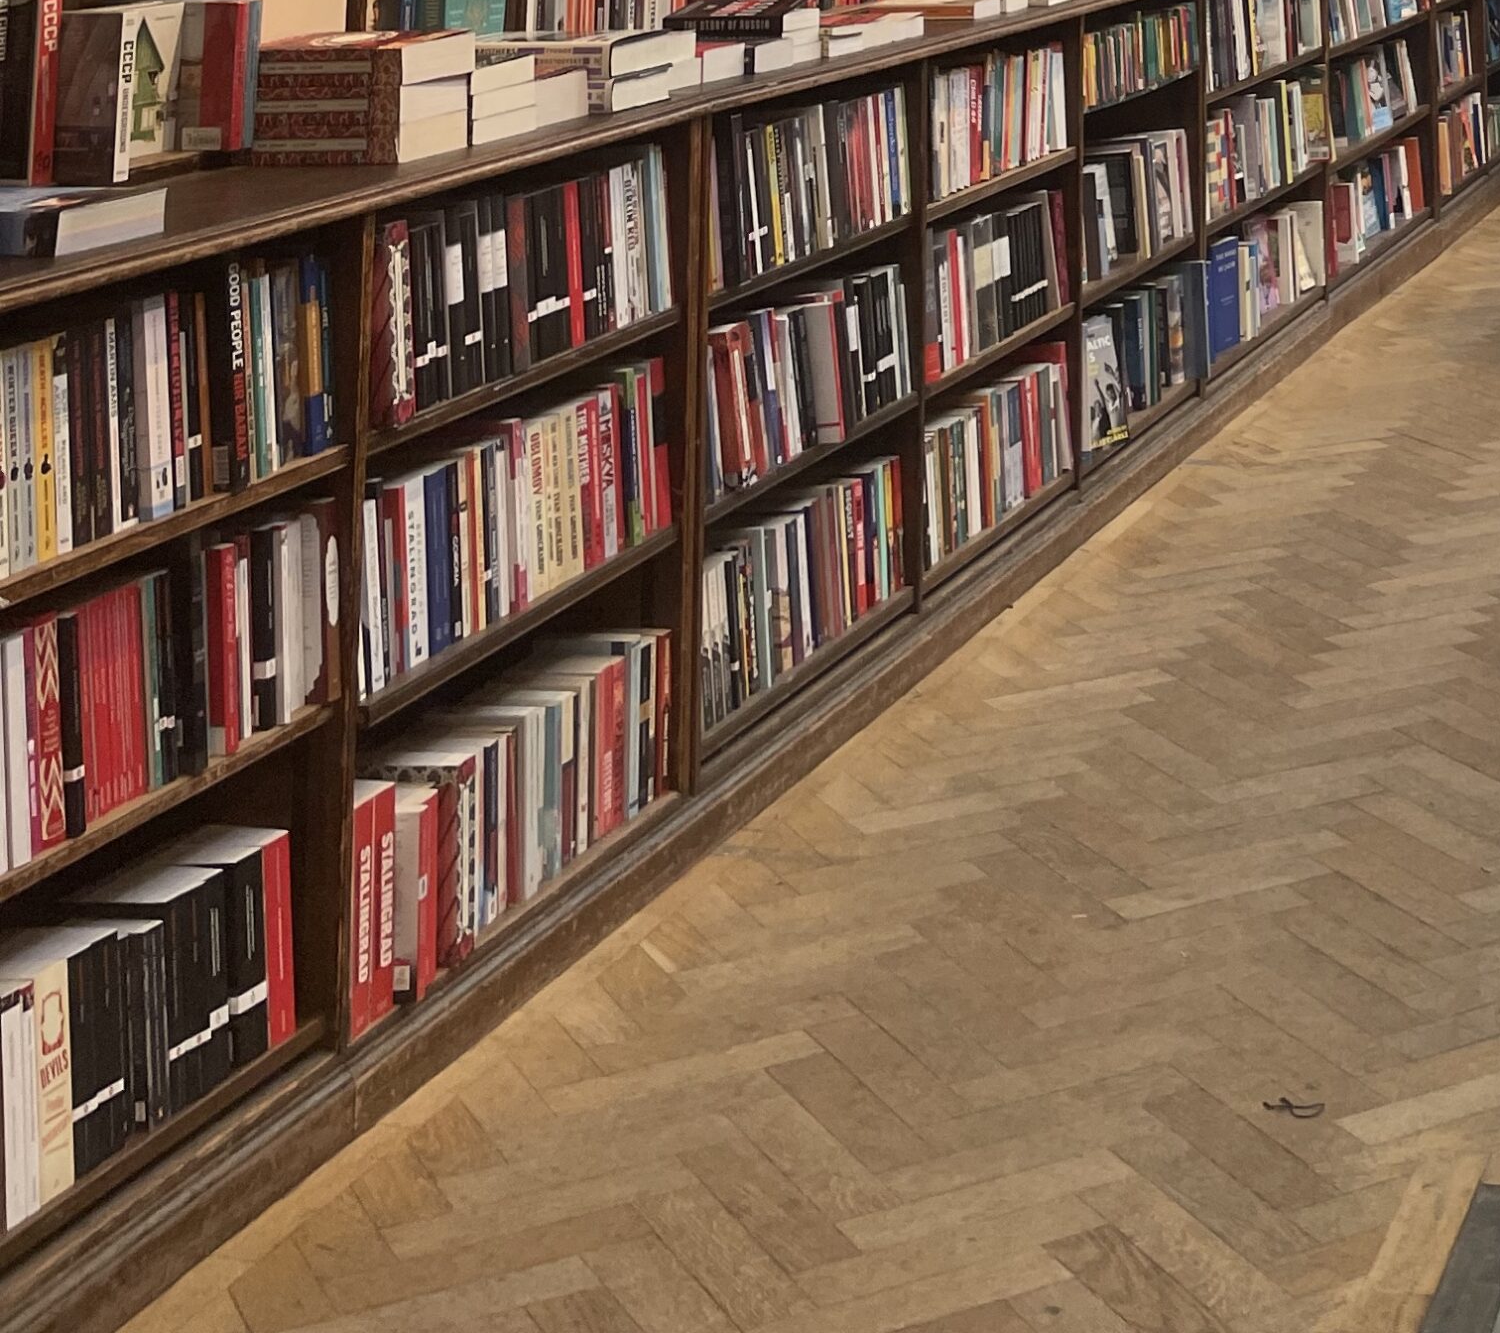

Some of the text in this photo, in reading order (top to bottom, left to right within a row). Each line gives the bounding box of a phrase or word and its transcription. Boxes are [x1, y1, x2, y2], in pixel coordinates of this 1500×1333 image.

[121, 40, 134, 84] CCCP
[228, 262, 243, 308] GOOD
[230, 309, 245, 371] PEOPLE
[1087, 335, 1112, 351] ALTIC
[107, 331, 119, 418] MARTIN AMIS
[235, 402, 248, 461] BARAM
[407, 510, 419, 636] STALINGRAD
[358, 844, 372, 984] STALINGRAD
[380, 830, 394, 968] STALINGRAD
[40, 1048, 70, 1090] DEVILS
